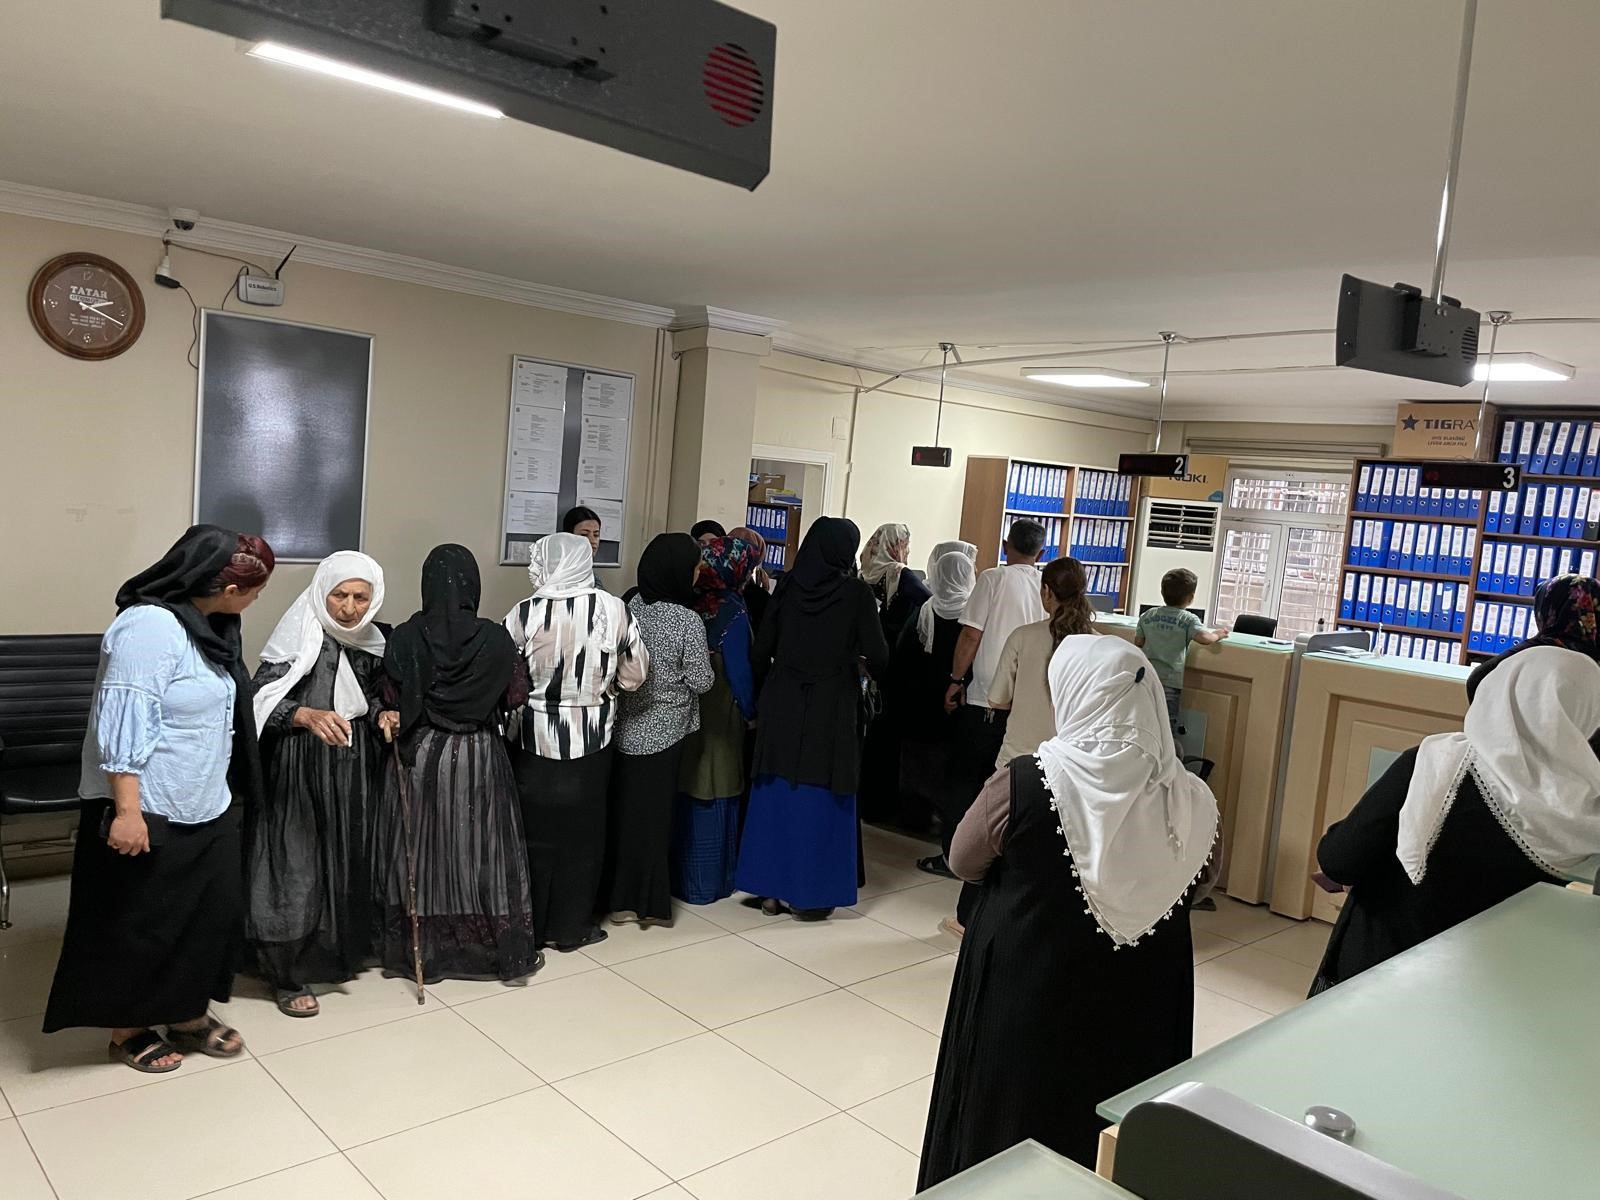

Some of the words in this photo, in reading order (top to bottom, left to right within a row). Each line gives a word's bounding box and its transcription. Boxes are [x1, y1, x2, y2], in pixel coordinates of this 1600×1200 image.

[70, 285, 108, 299] TATAR
[1423, 419, 1475, 431] TIGRA
[1173, 456, 1184, 475] 2
[1502, 467, 1515, 489] 3
